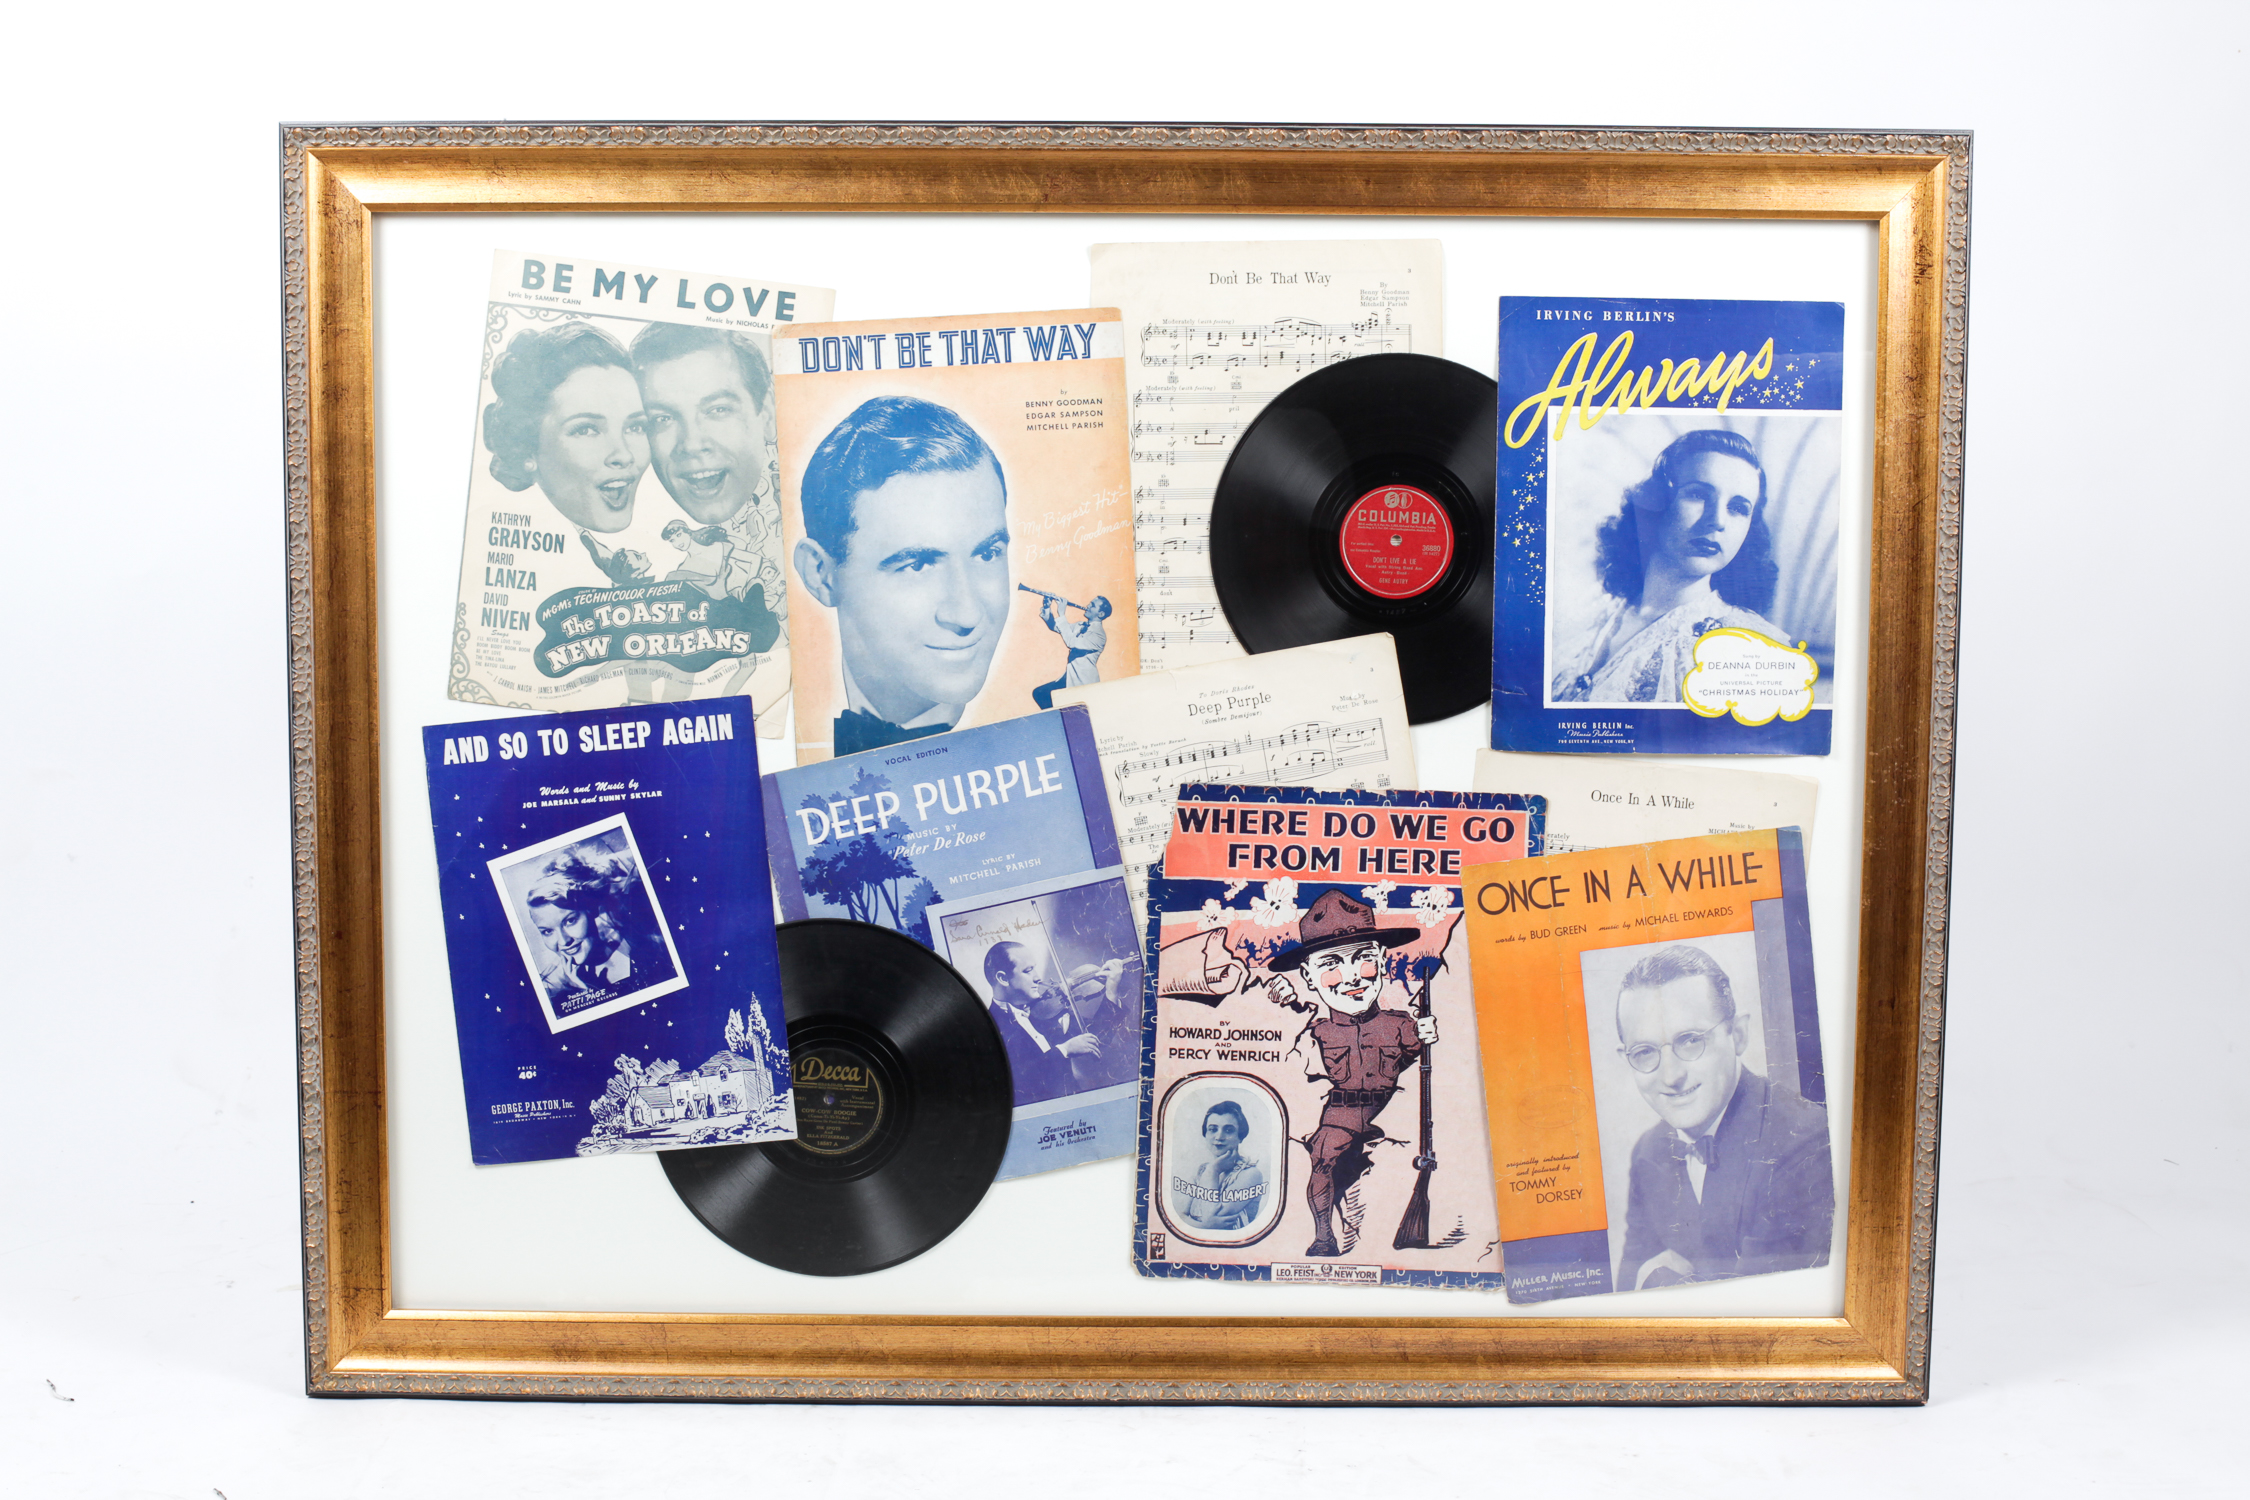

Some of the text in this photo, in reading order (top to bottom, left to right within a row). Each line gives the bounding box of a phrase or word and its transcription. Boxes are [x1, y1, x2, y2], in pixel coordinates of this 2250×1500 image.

[1209, 270, 1332, 287] Don't Be That Way
[522, 260, 796, 321] BE MY LOVE
[706, 316, 723, 324] Music
[736, 320, 768, 329] NICHOLAS
[1536, 310, 1675, 322] IRVING BERLIN'S
[799, 323, 1096, 373] DON'T BE THAT WAY
[1504, 330, 1774, 449] Always
[1025, 398, 1102, 408] BENNY GOODMAN
[1026, 410, 1103, 420] EDGAR SAMPSON
[1026, 423, 1068, 431] MITCHELL
[491, 512, 531, 527] KATHRYN
[1358, 510, 1436, 525] COLUMBIA
[488, 526, 565, 554] GRAYSON
[1026, 519, 1131, 564] Benny Goodman
[487, 552, 514, 566] MARIO
[485, 567, 536, 591] LANZA
[483, 592, 508, 606] DAVID
[574, 581, 683, 606] TECHNICOLOR FIESTA!
[481, 608, 530, 631] NIVEN
[562, 600, 709, 638] The TOAST of
[545, 626, 751, 673] NEW ORLEANS
[1708, 662, 1796, 670] DEANNA DURBIN
[1188, 692, 1272, 716] Deep Purple
[444, 714, 733, 765] AND SO TO SLEEP AGAIN
[885, 747, 948, 766] VOCAL EDITION
[540, 779, 639, 796] Words and Music by
[541, 798, 579, 807] MARSALA
[581, 795, 597, 804] and
[598, 794, 626, 802] SUNNY
[630, 791, 662, 799] SKYLAR
[795, 753, 1063, 846] DEEP PURPLE
[1591, 789, 1695, 810] Once In A While
[907, 823, 957, 840] MUSIC BY
[1178, 807, 1515, 843] WHERE DO WE GO
[894, 829, 986, 860] Peter De Rose
[982, 855, 1003, 865] LYRIC
[1228, 844, 1461, 876] FROM HERE
[949, 858, 1042, 885] MITCHELL PARISH
[1478, 852, 1763, 916] ONCE IN A WHILE
[1598, 906, 1734, 932] music by MICHAEL EDWARDS
[1495, 924, 1587, 944] words by BUD GREEN
[561, 989, 606, 1010] PATTI PAGE
[1170, 1027, 1282, 1041] HOWARD JOHNSON
[1169, 1048, 1280, 1062] PERCY WENRICH
[801, 1057, 861, 1081] Decca
[491, 1099, 575, 1115] GEORGE PAXTON, Inc.
[1038, 1125, 1096, 1144] JOE VENUTI
[1043, 1121, 1074, 1136] Featured
[1041, 1142, 1052, 1150] and
[1067, 1135, 1096, 1145] Orchestra
[1506, 1152, 1580, 1168] originally introduced
[1531, 1165, 1560, 1176] featured
[1173, 1176, 1269, 1202] BEATRICE LAMBERT
[1510, 1177, 1557, 1192] TOMMY
[1536, 1189, 1583, 1204] DORSEY
[1276, 1269, 1377, 1279] LEO. FEIST NEW YORK
